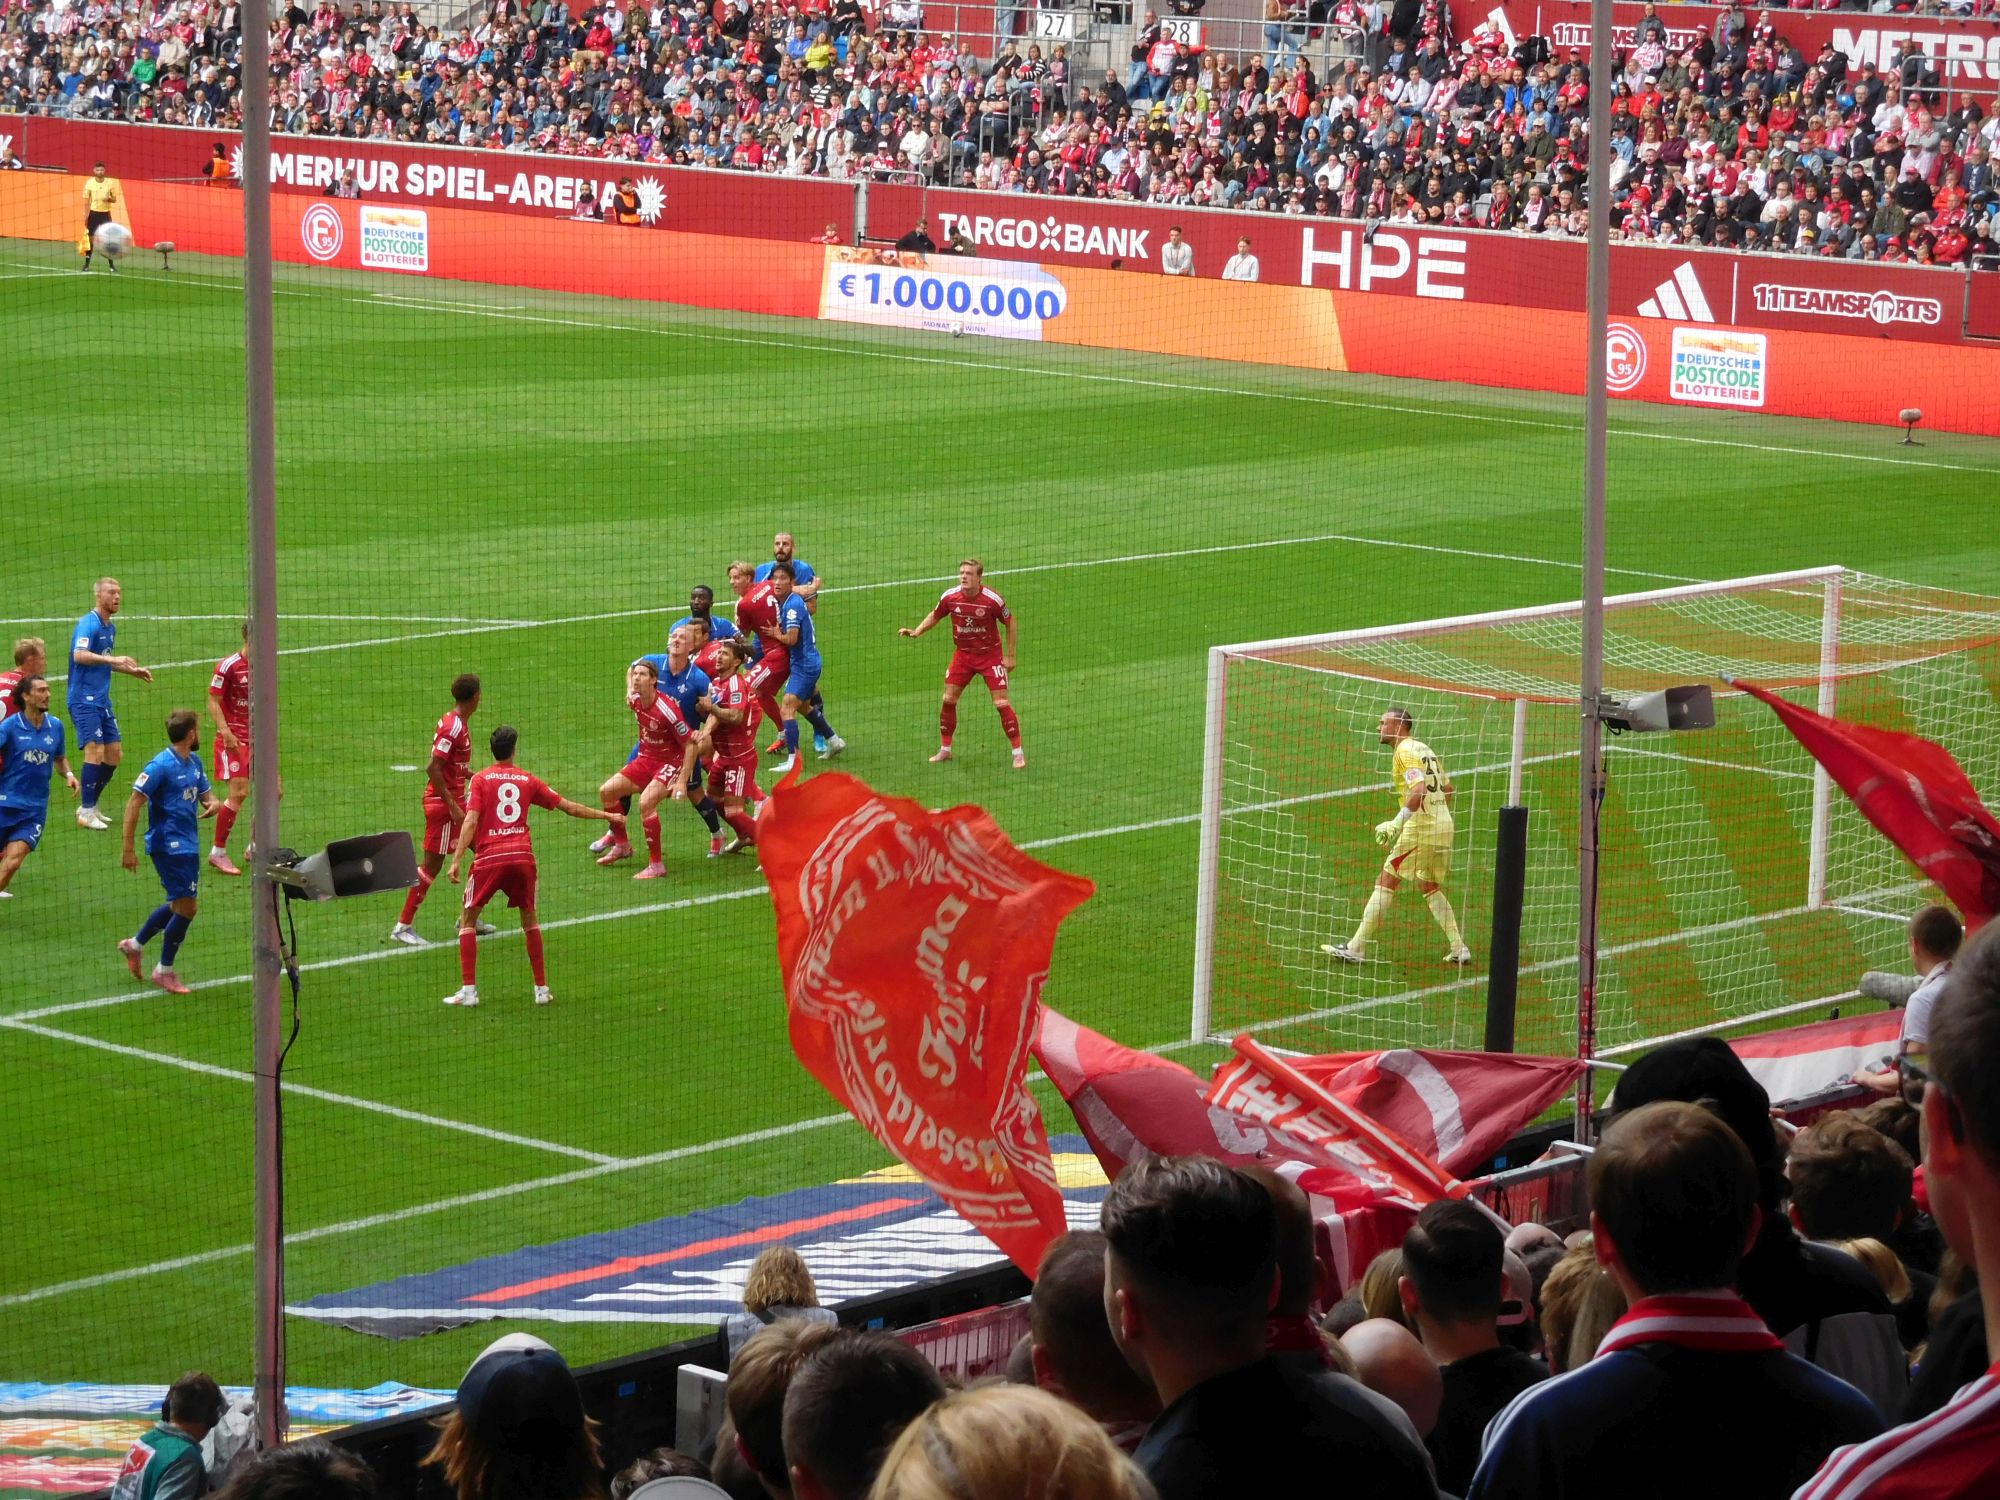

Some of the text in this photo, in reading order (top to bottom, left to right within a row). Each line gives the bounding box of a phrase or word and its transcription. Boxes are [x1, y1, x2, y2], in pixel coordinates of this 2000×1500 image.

[1044, 15, 1065, 36] 27
[1169, 20, 1191, 42] 28
[270, 152, 400, 193] MERKUR
[371, 228, 417, 240] DEUTSCHE
[364, 237, 425, 256] POSTCODE
[371, 253, 417, 266] LOTTERIE
[1301, 227, 1467, 300] HPE
[864, 272, 1060, 320] 1.000.000
[1686, 353, 1751, 369] DEUTSCHE
[1675, 364, 1760, 388] POSTCODE
[1685, 383, 1750, 400] LOTTERIE
[992, 664, 1004, 678] 10
[659, 763, 676, 777] 13
[496, 783, 521, 823] 8
